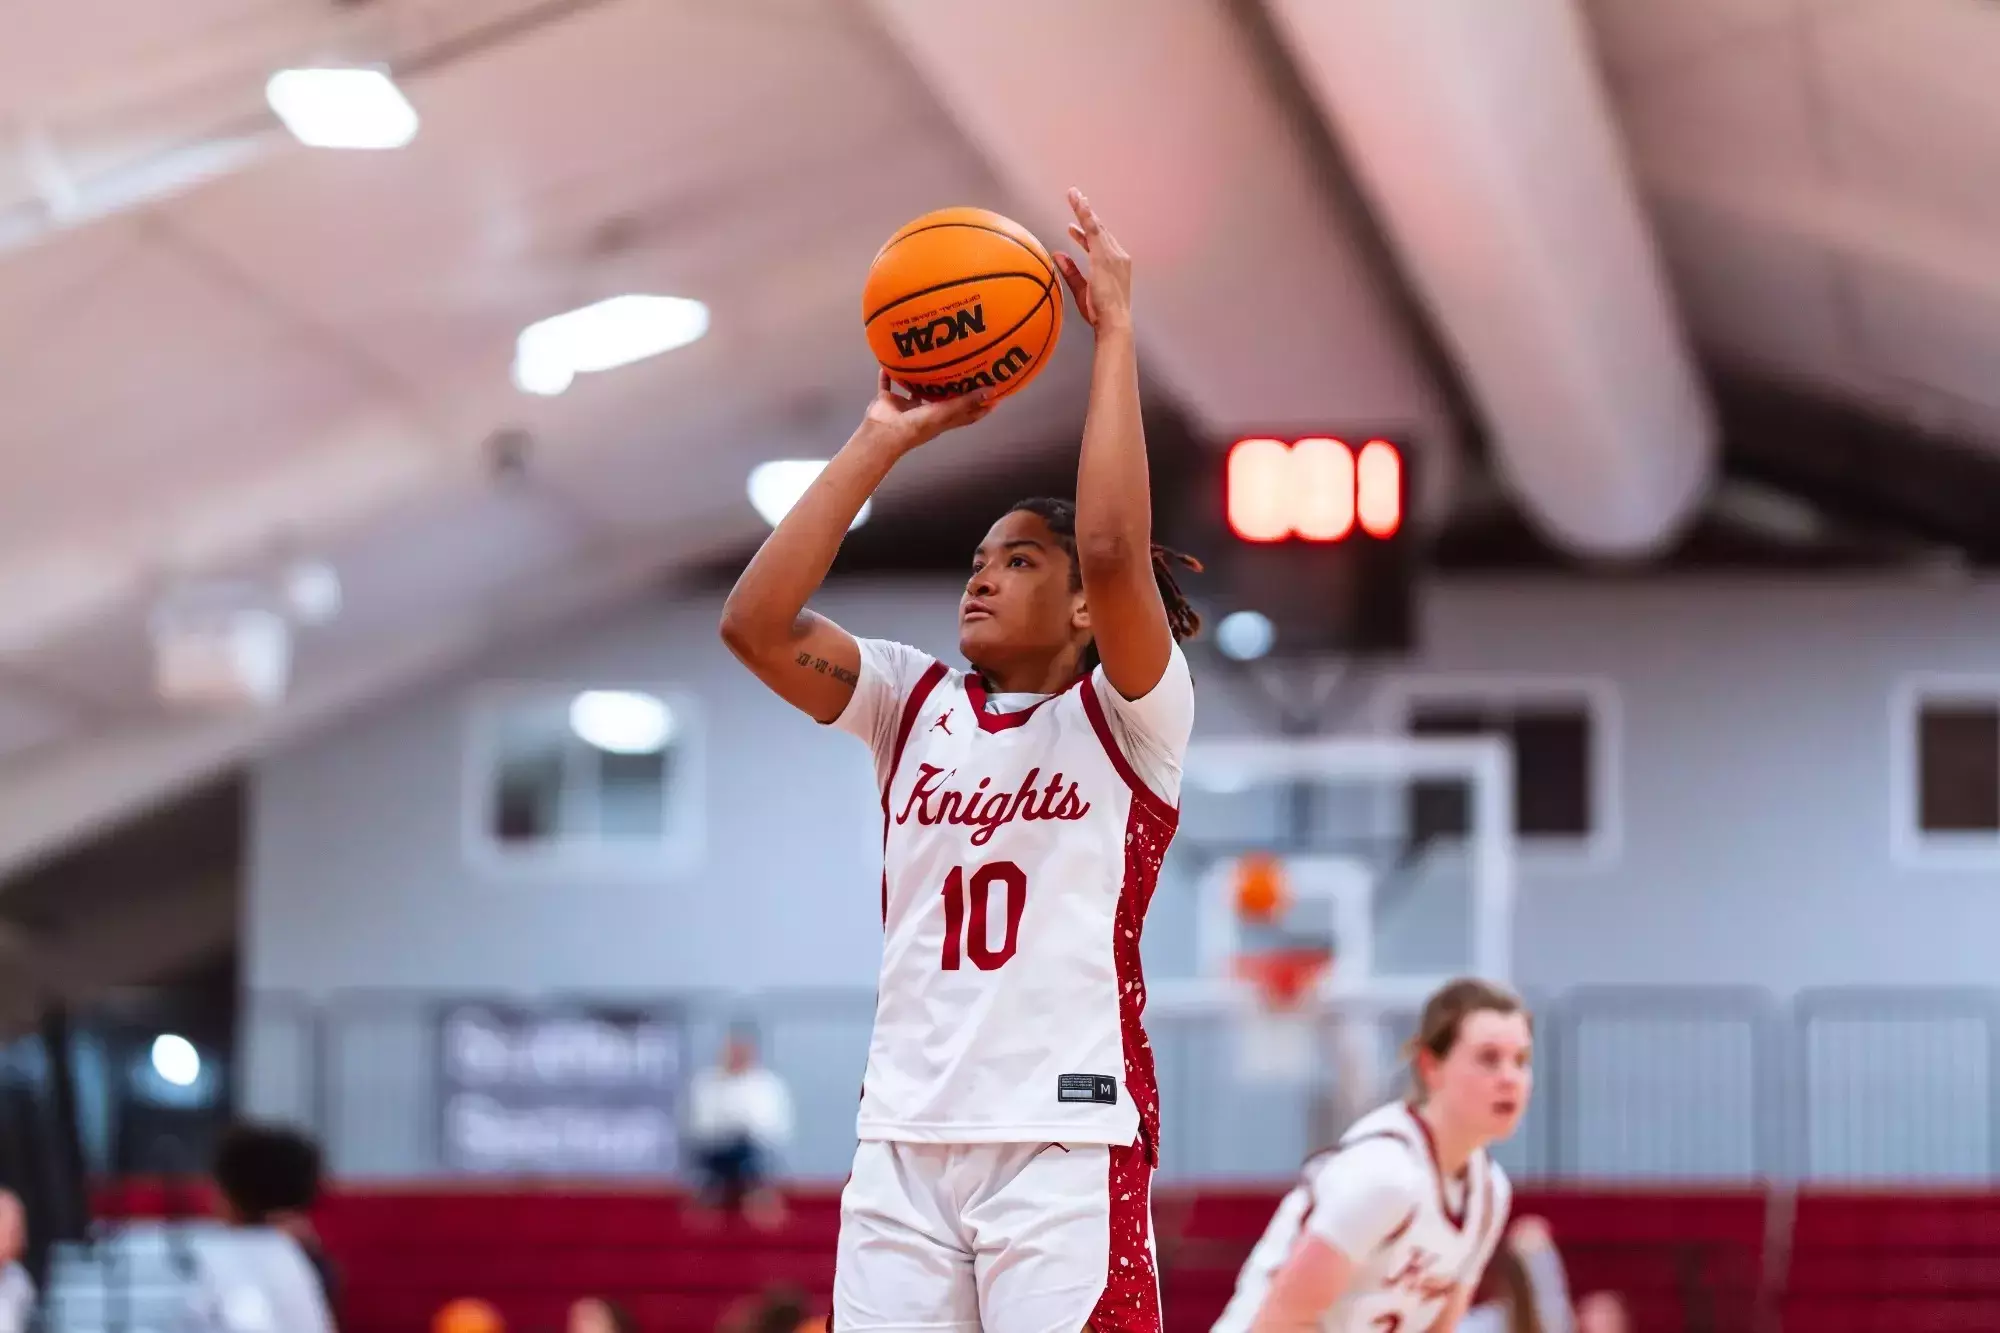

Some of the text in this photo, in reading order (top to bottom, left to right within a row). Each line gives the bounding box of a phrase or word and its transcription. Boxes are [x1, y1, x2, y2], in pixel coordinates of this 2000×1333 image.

[911, 310, 937, 322] GAME
[940, 294, 981, 312] OFFICIAL
[892, 303, 986, 358] NCAA
[896, 763, 1091, 846] Knights
[941, 861, 1027, 970] 10
[1100, 1083, 1111, 1095] M
